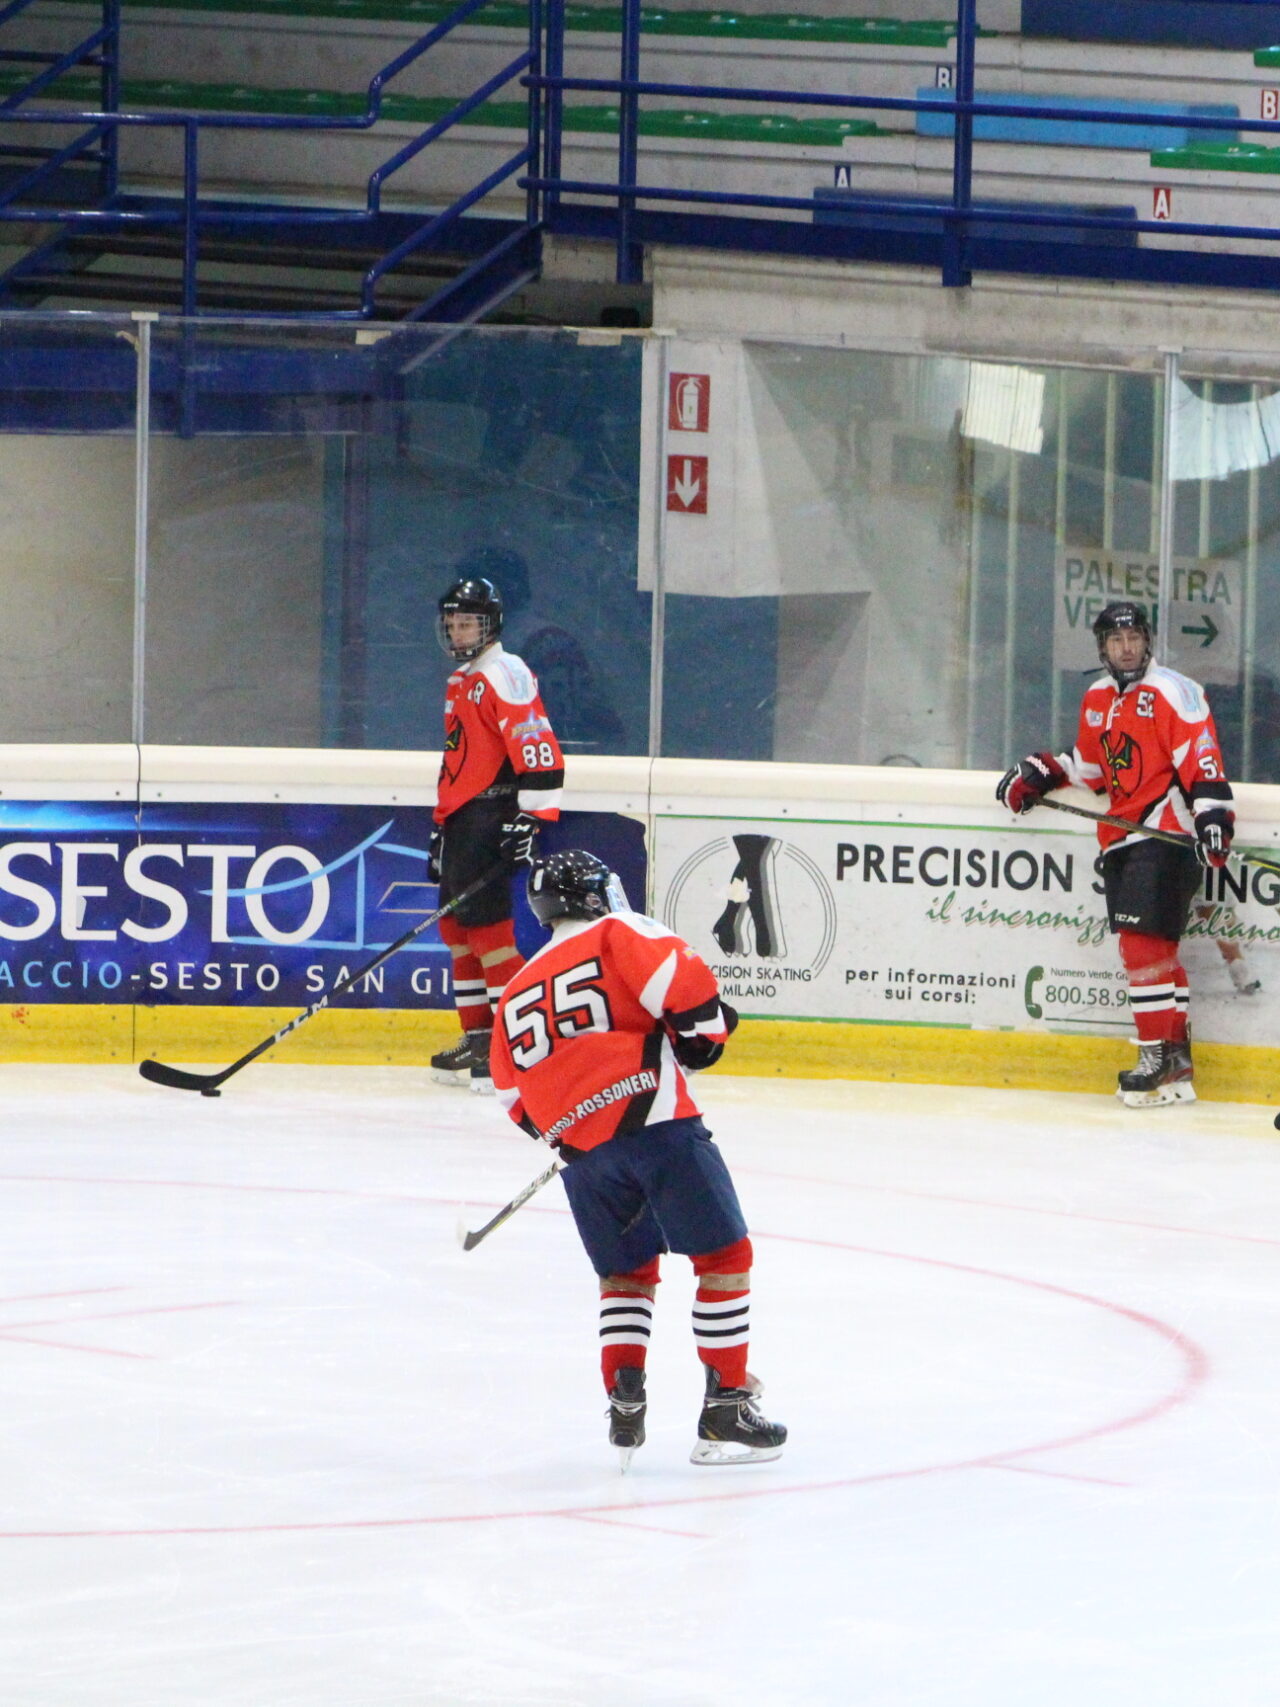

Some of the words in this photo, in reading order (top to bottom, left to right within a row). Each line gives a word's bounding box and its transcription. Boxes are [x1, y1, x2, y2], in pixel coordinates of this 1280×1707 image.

[937, 67, 951, 88] B
[1262, 91, 1276, 118] B
[834, 167, 851, 188] A
[1154, 193, 1170, 219] A
[1065, 558, 1232, 605] PALESTRA
[521, 742, 555, 769] 88
[836, 843, 1074, 893] PRECISION
[0, 841, 331, 945] SESTO
[926, 890, 955, 921] il
[305, 964, 385, 994] SAN
[756, 966, 812, 982] SKATING
[845, 967, 879, 987] per
[888, 968, 1017, 989] informazioni
[1050, 967, 1086, 978] Numero
[1088, 968, 1113, 980] Verde
[722, 984, 777, 998] MILANO
[884, 987, 912, 1002] sui
[921, 988, 977, 1005] corsi:
[1045, 985, 1132, 1008] 800.58.9
[502, 955, 616, 1072] 55
[574, 1070, 658, 1120] ROSSONERI
